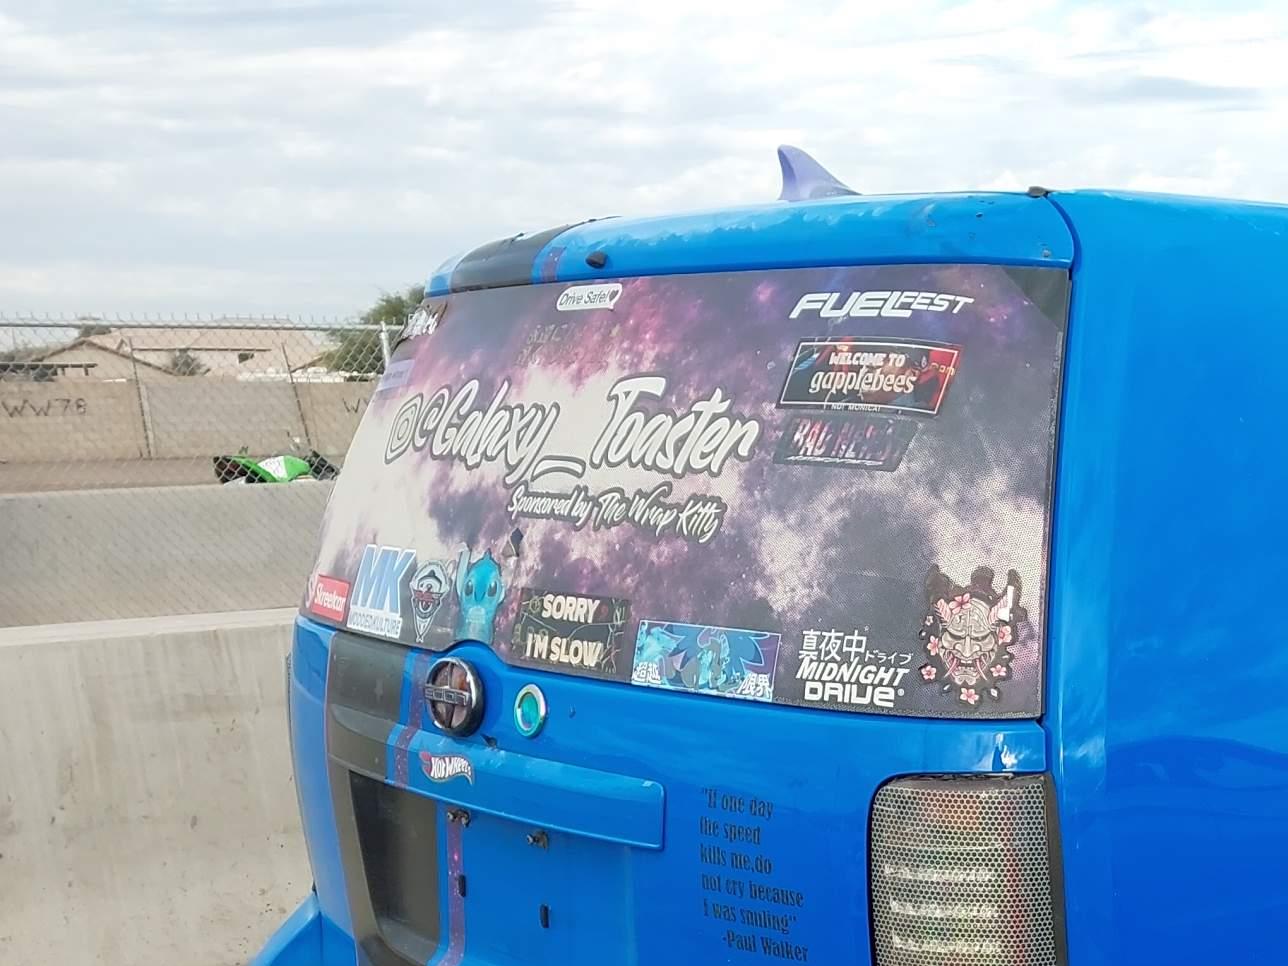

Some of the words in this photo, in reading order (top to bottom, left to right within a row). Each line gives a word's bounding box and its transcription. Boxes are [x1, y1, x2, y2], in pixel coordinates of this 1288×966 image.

[559, 292, 583, 306] Drive
[584, 289, 609, 304] Safe!
[789, 291, 975, 319] FUELFEST
[829, 352, 885, 367] WELCOME
[888, 353, 907, 367] TO
[809, 364, 918, 394] gapplebees
[507, 486, 572, 520] Sponsored
[573, 491, 593, 526] by
[594, 492, 626, 524] The
[628, 485, 677, 537] Wrap
[676, 501, 723, 543] Kitty
[351, 543, 416, 615] MK
[541, 593, 601, 624] SORRY
[525, 632, 549, 660] I'M
[549, 636, 604, 667] SLOW
[798, 628, 868, 661] 真夜中
[796, 656, 911, 687] MIDNIGHT
[430, 756, 446, 779] HOT
[721, 793, 745, 814] one
[750, 796, 774, 821] day
[699, 815, 719, 837] the
[723, 822, 761, 845] speed
[699, 843, 726, 866] kills
[702, 873, 721, 892] not
[725, 877, 745, 899] cry
[749, 880, 804, 909] because
[703, 898, 709, 917] I
[712, 902, 737, 922] was
[760, 936, 809, 962] Walker
